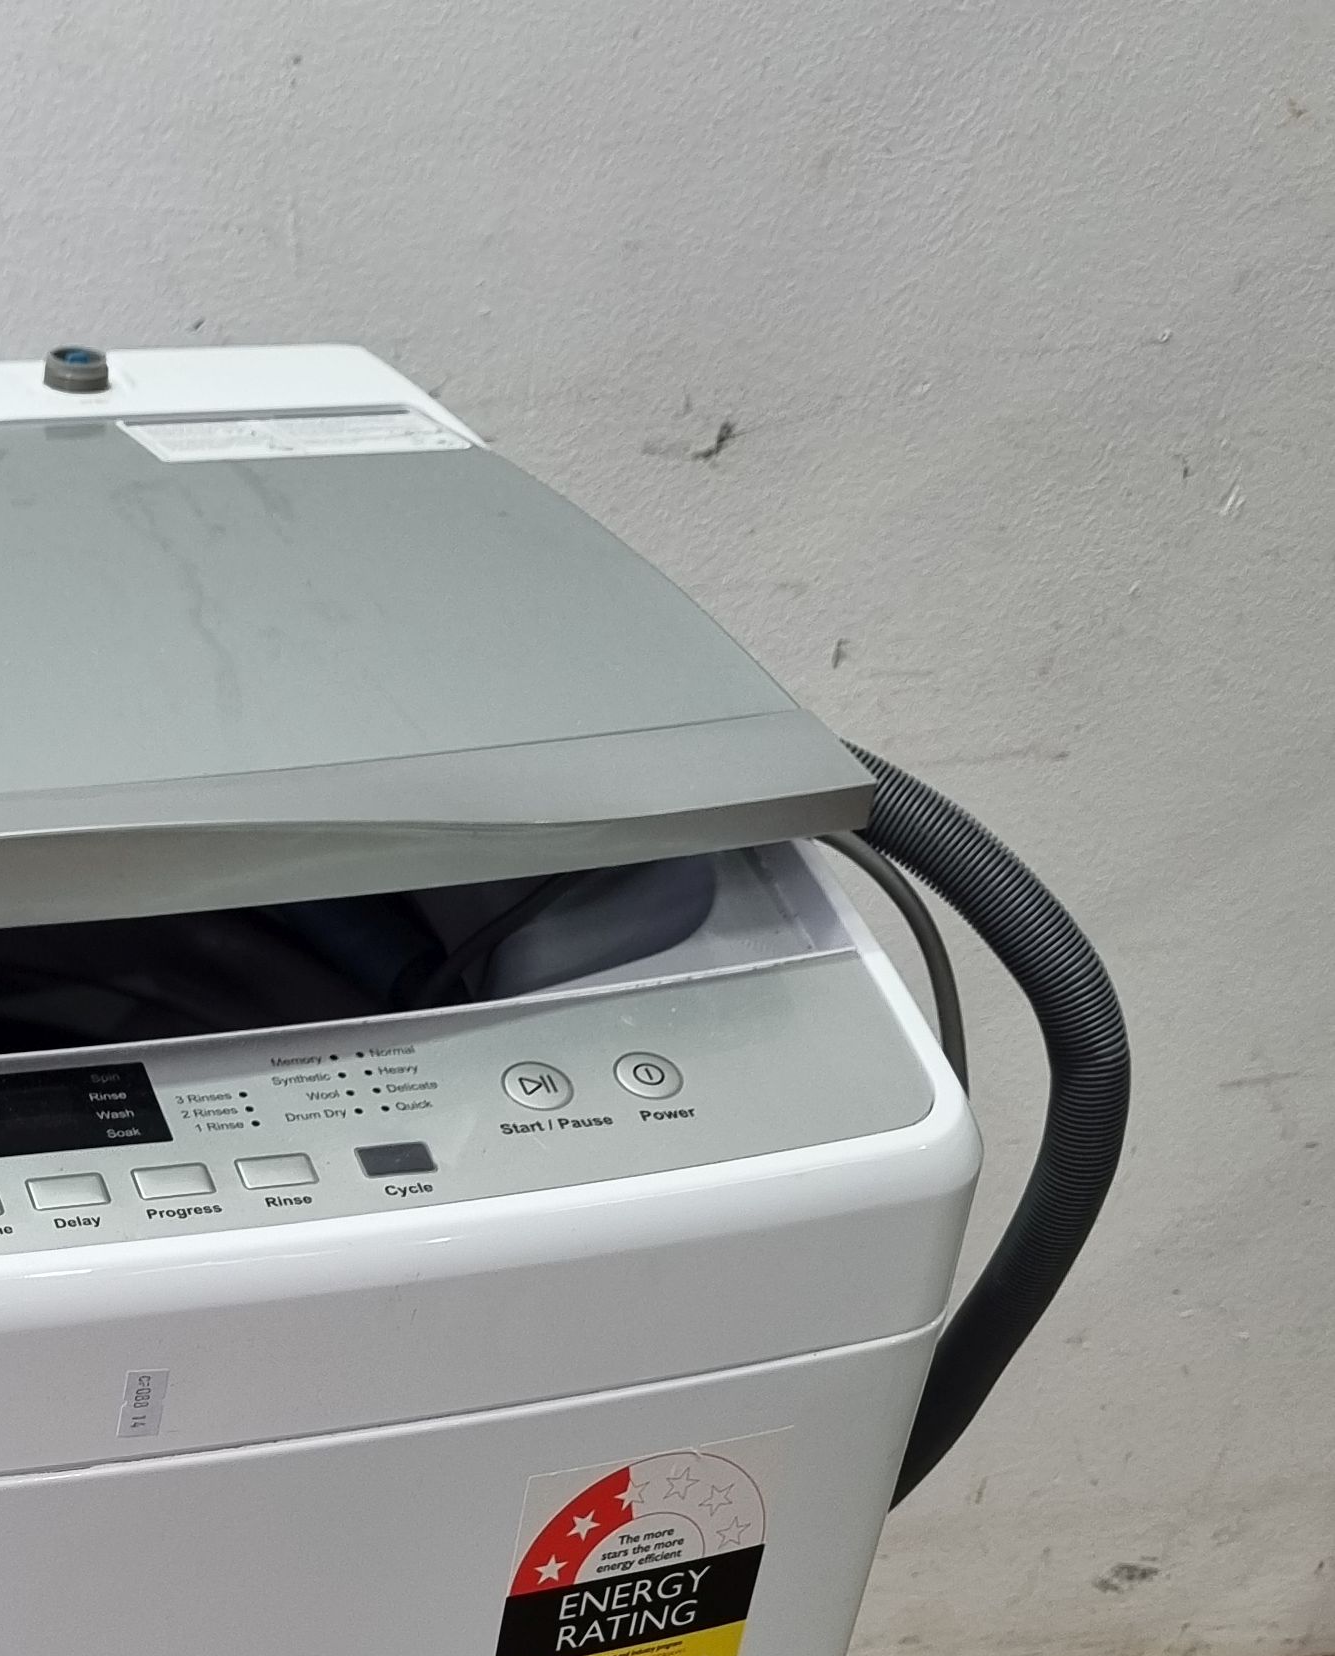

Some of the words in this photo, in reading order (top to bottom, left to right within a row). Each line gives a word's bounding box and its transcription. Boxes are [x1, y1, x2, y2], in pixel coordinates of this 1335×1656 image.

[369, 1045, 416, 1058] Normal
[270, 1054, 322, 1068] Memory
[378, 1064, 418, 1077] Heavy
[90, 1072, 120, 1085] Spin
[271, 1071, 331, 1087] Synthetic
[386, 1080, 438, 1094] Delicate
[89, 1090, 127, 1102] Rinse
[175, 1095, 184, 1105] 3
[187, 1092, 232, 1104] Rinses
[306, 1089, 340, 1101] Wool
[181, 1110, 190, 1119] 2
[193, 1106, 238, 1118] Rinses
[396, 1099, 433, 1112] Quick
[96, 1108, 135, 1121] Wash
[285, 1110, 321, 1123] Drum
[324, 1107, 347, 1121] Dry
[639, 1107, 695, 1122] Power
[207, 1119, 244, 1131] Rinse
[500, 1120, 545, 1135] Start
[557, 1115, 614, 1131] Pause
[106, 1126, 141, 1139] Soak
[385, 1182, 433, 1197] Cycle
[265, 1194, 313, 1208] Rinse
[146, 1203, 222, 1220] Progress
[54, 1215, 101, 1229] Delay
[619, 1533, 641, 1546] The
[643, 1527, 675, 1541] more
[601, 1548, 629, 1562] stars
[632, 1542, 651, 1554] the
[653, 1536, 685, 1550] more
[596, 1559, 636, 1574] energy
[638, 1548, 682, 1565] efficient
[558, 1565, 711, 1621] ENERGY
[555, 1599, 698, 1652] RATING
